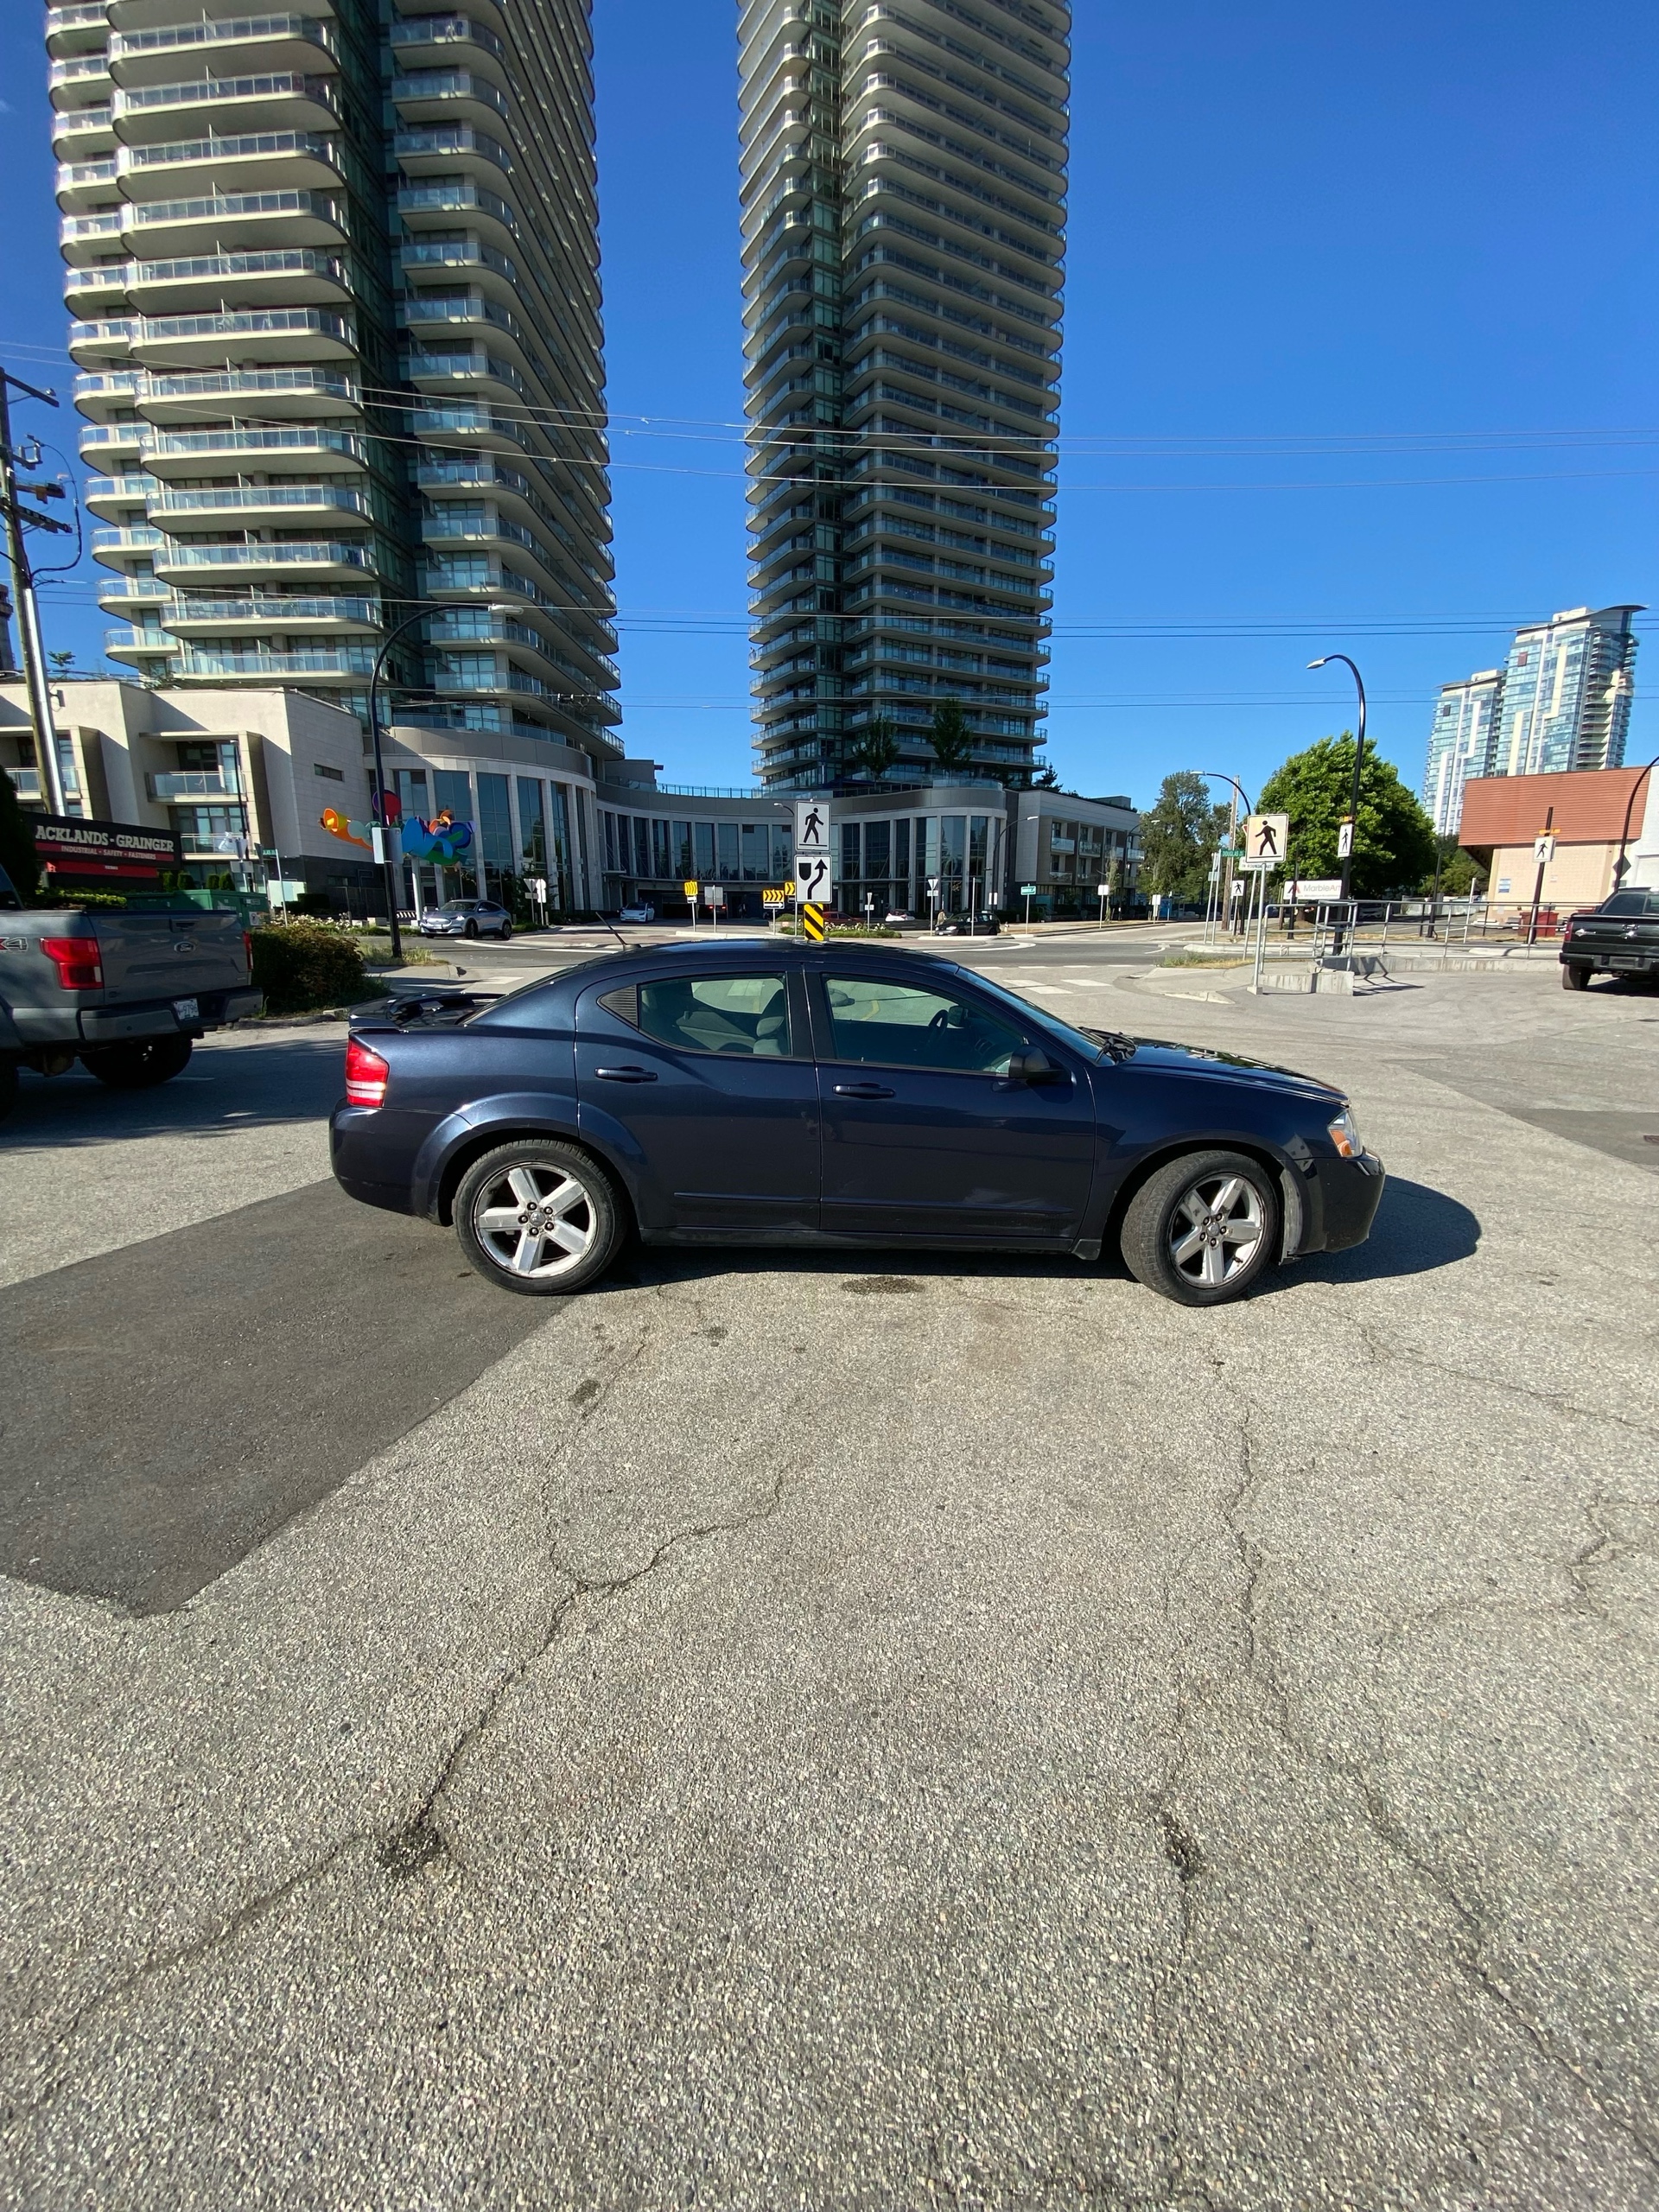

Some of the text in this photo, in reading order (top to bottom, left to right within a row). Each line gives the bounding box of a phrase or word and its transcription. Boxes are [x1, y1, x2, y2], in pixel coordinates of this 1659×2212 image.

[35, 825, 109, 845] ACKLANDS
[116, 834, 174, 852] GRAINGER
[61, 845, 98, 855] INDUSTRIAL
[128, 851, 156, 861] FASTENERS
